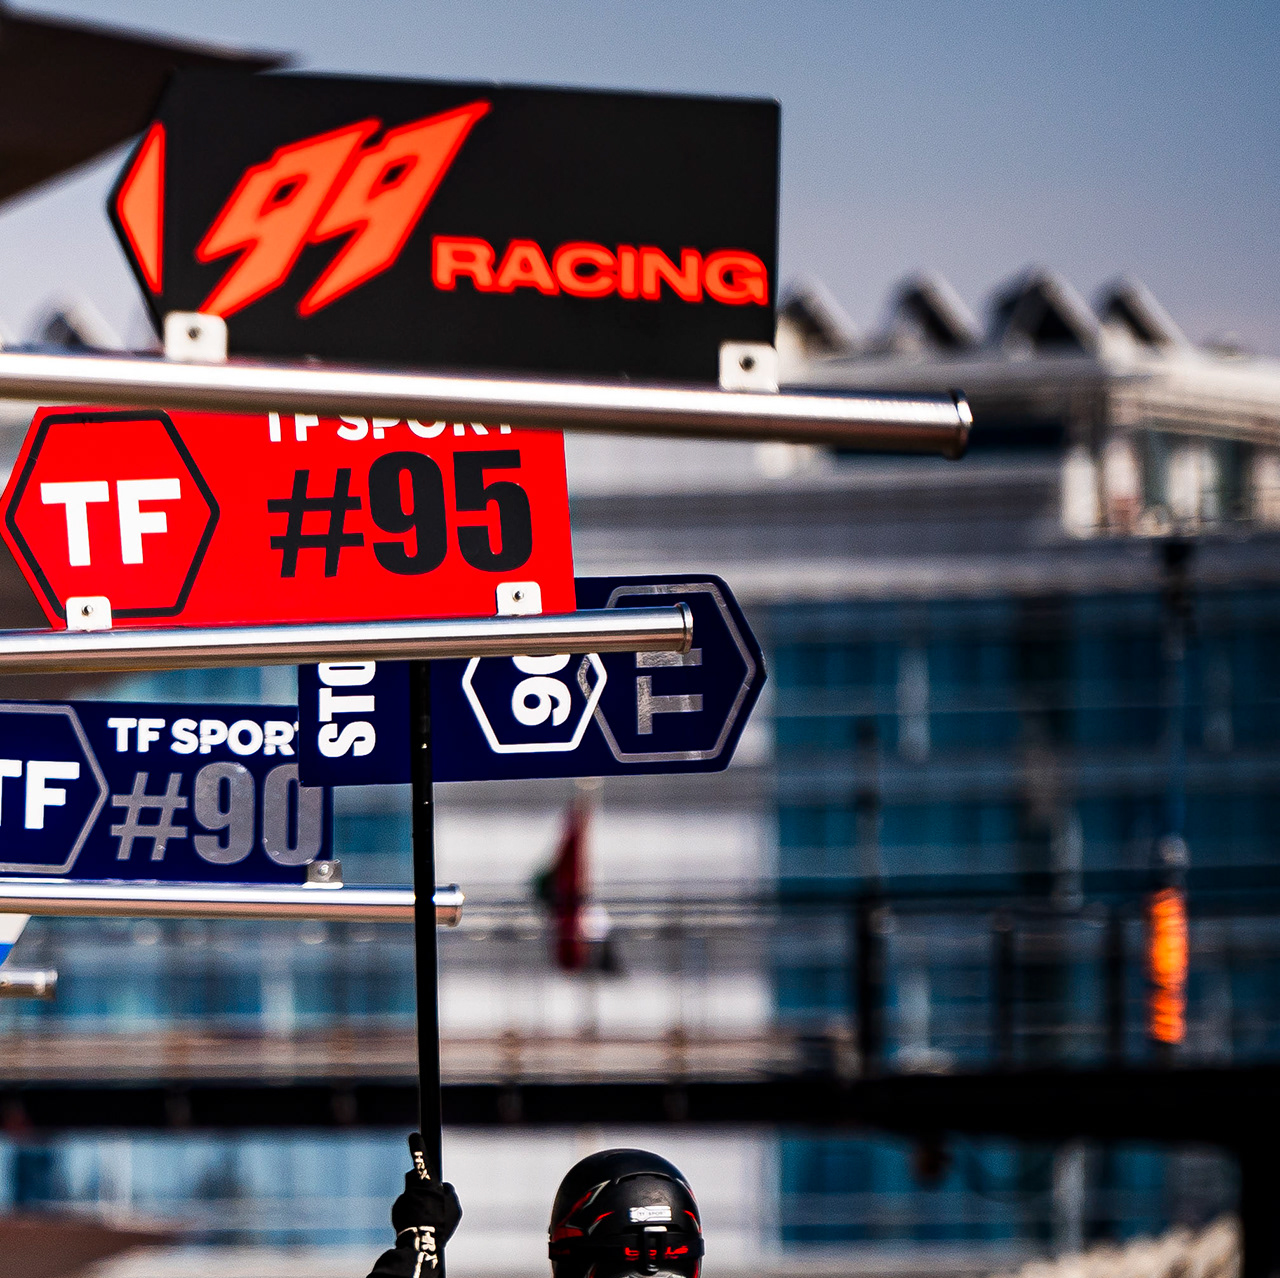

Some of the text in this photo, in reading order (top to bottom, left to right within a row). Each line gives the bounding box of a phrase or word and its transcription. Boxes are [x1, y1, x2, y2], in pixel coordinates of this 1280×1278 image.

[196, 99, 493, 318] 99
[430, 233, 770, 306] RACING
[39, 477, 182, 567] TF
[266, 449, 534, 579] #95
[107, 718, 300, 757] TF SPOR
[111, 761, 324, 867] #90
